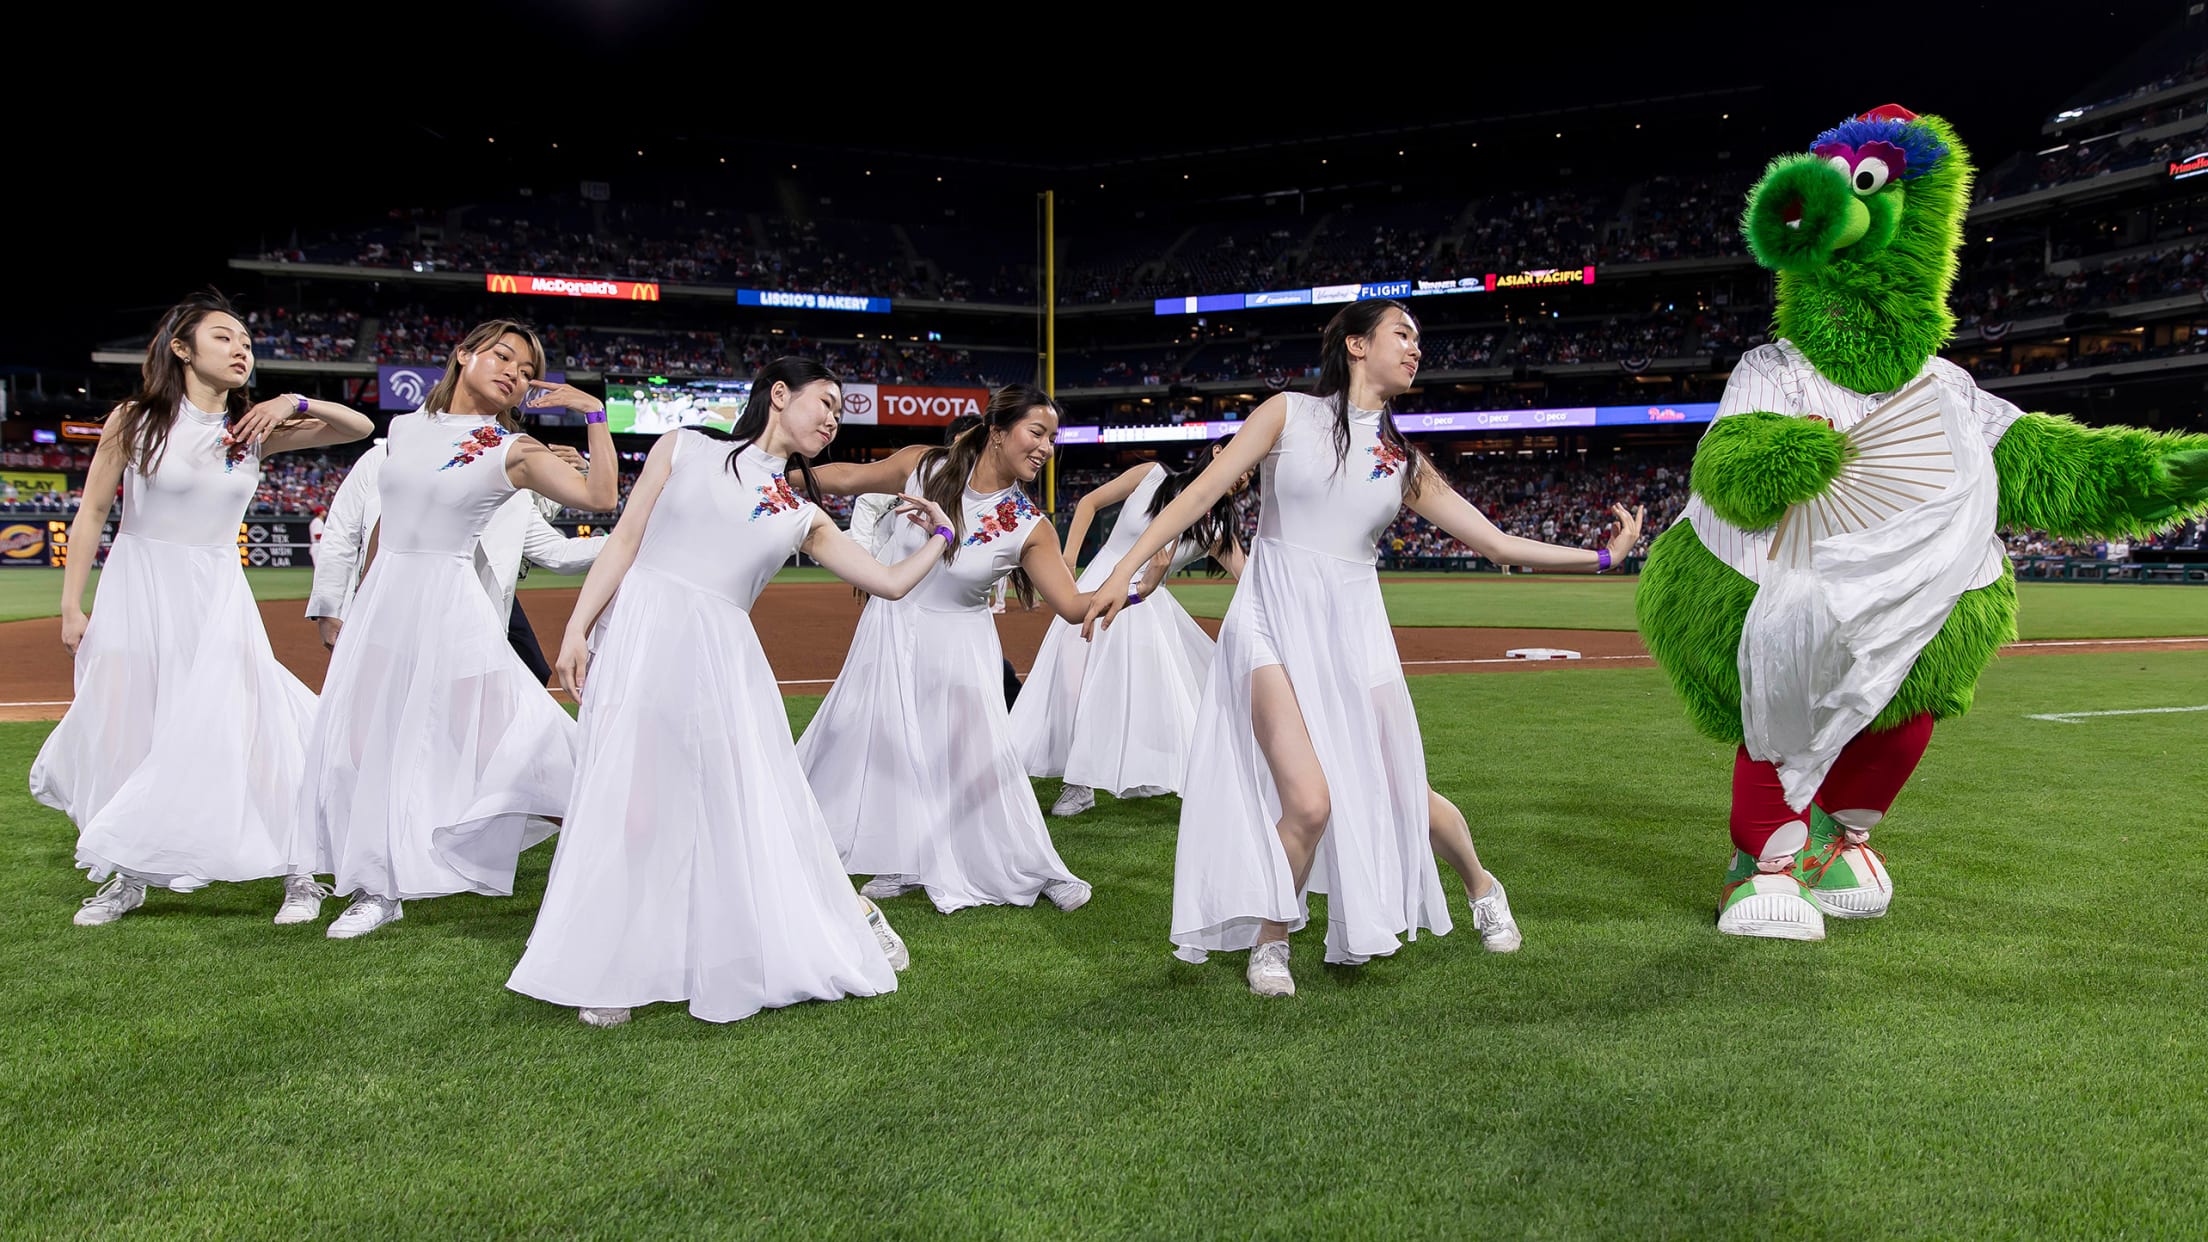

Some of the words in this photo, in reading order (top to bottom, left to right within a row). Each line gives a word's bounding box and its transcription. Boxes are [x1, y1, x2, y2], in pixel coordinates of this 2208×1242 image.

[1497, 274, 1533, 287] ASIAN
[1535, 270, 1583, 283] PACIFIC
[531, 278, 618, 295] McDonald's
[1361, 284, 1408, 297] FLIGHT
[760, 291, 815, 308] LISCIO'S
[817, 295, 869, 311] BAKERY
[883, 395, 981, 417] TOYOTA
[1433, 417, 1454, 426] peco
[1489, 415, 1509, 424] peco
[1546, 413, 1567, 422] peco
[13, 479, 54, 490] PLAY
[271, 534, 290, 544] TEX
[271, 557, 291, 567] LAA
